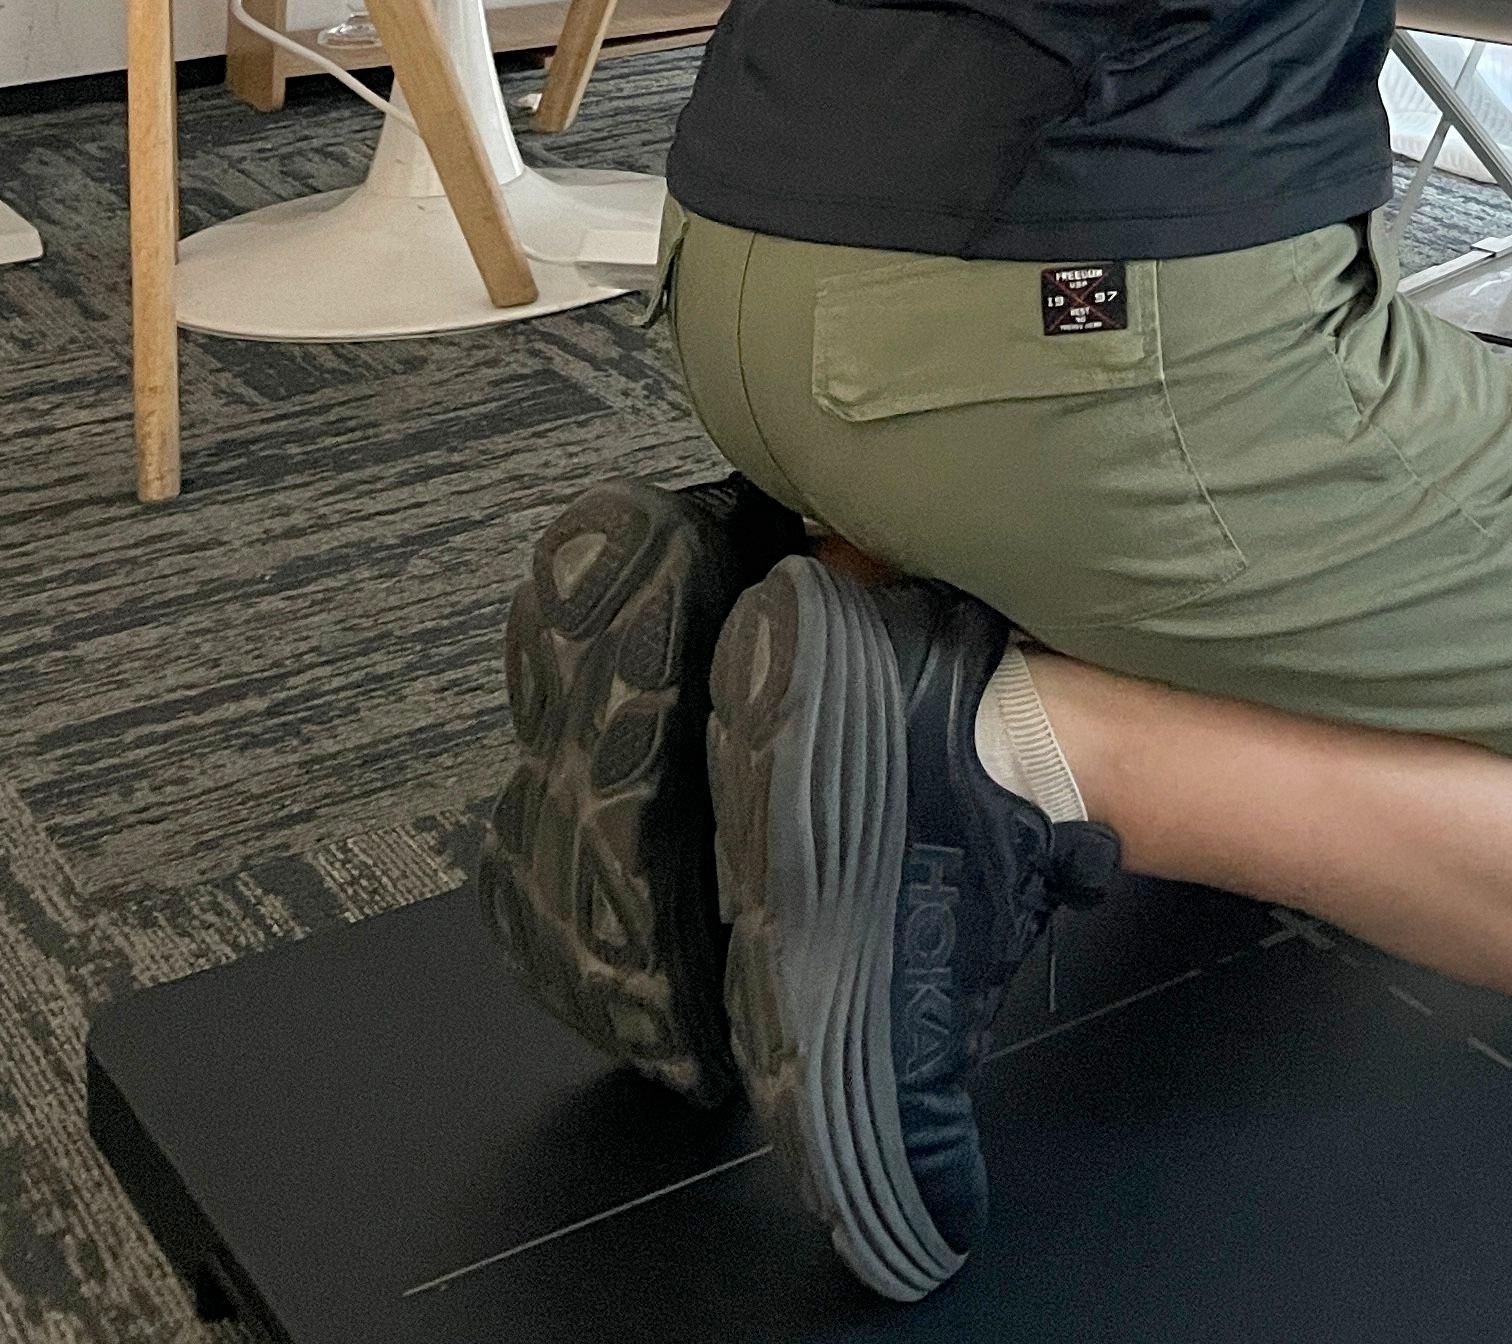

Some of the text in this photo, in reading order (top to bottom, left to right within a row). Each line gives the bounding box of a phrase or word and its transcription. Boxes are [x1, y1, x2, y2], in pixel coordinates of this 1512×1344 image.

[1047, 290, 1118, 308] 19 97
[903, 841, 964, 1081] HOKA
